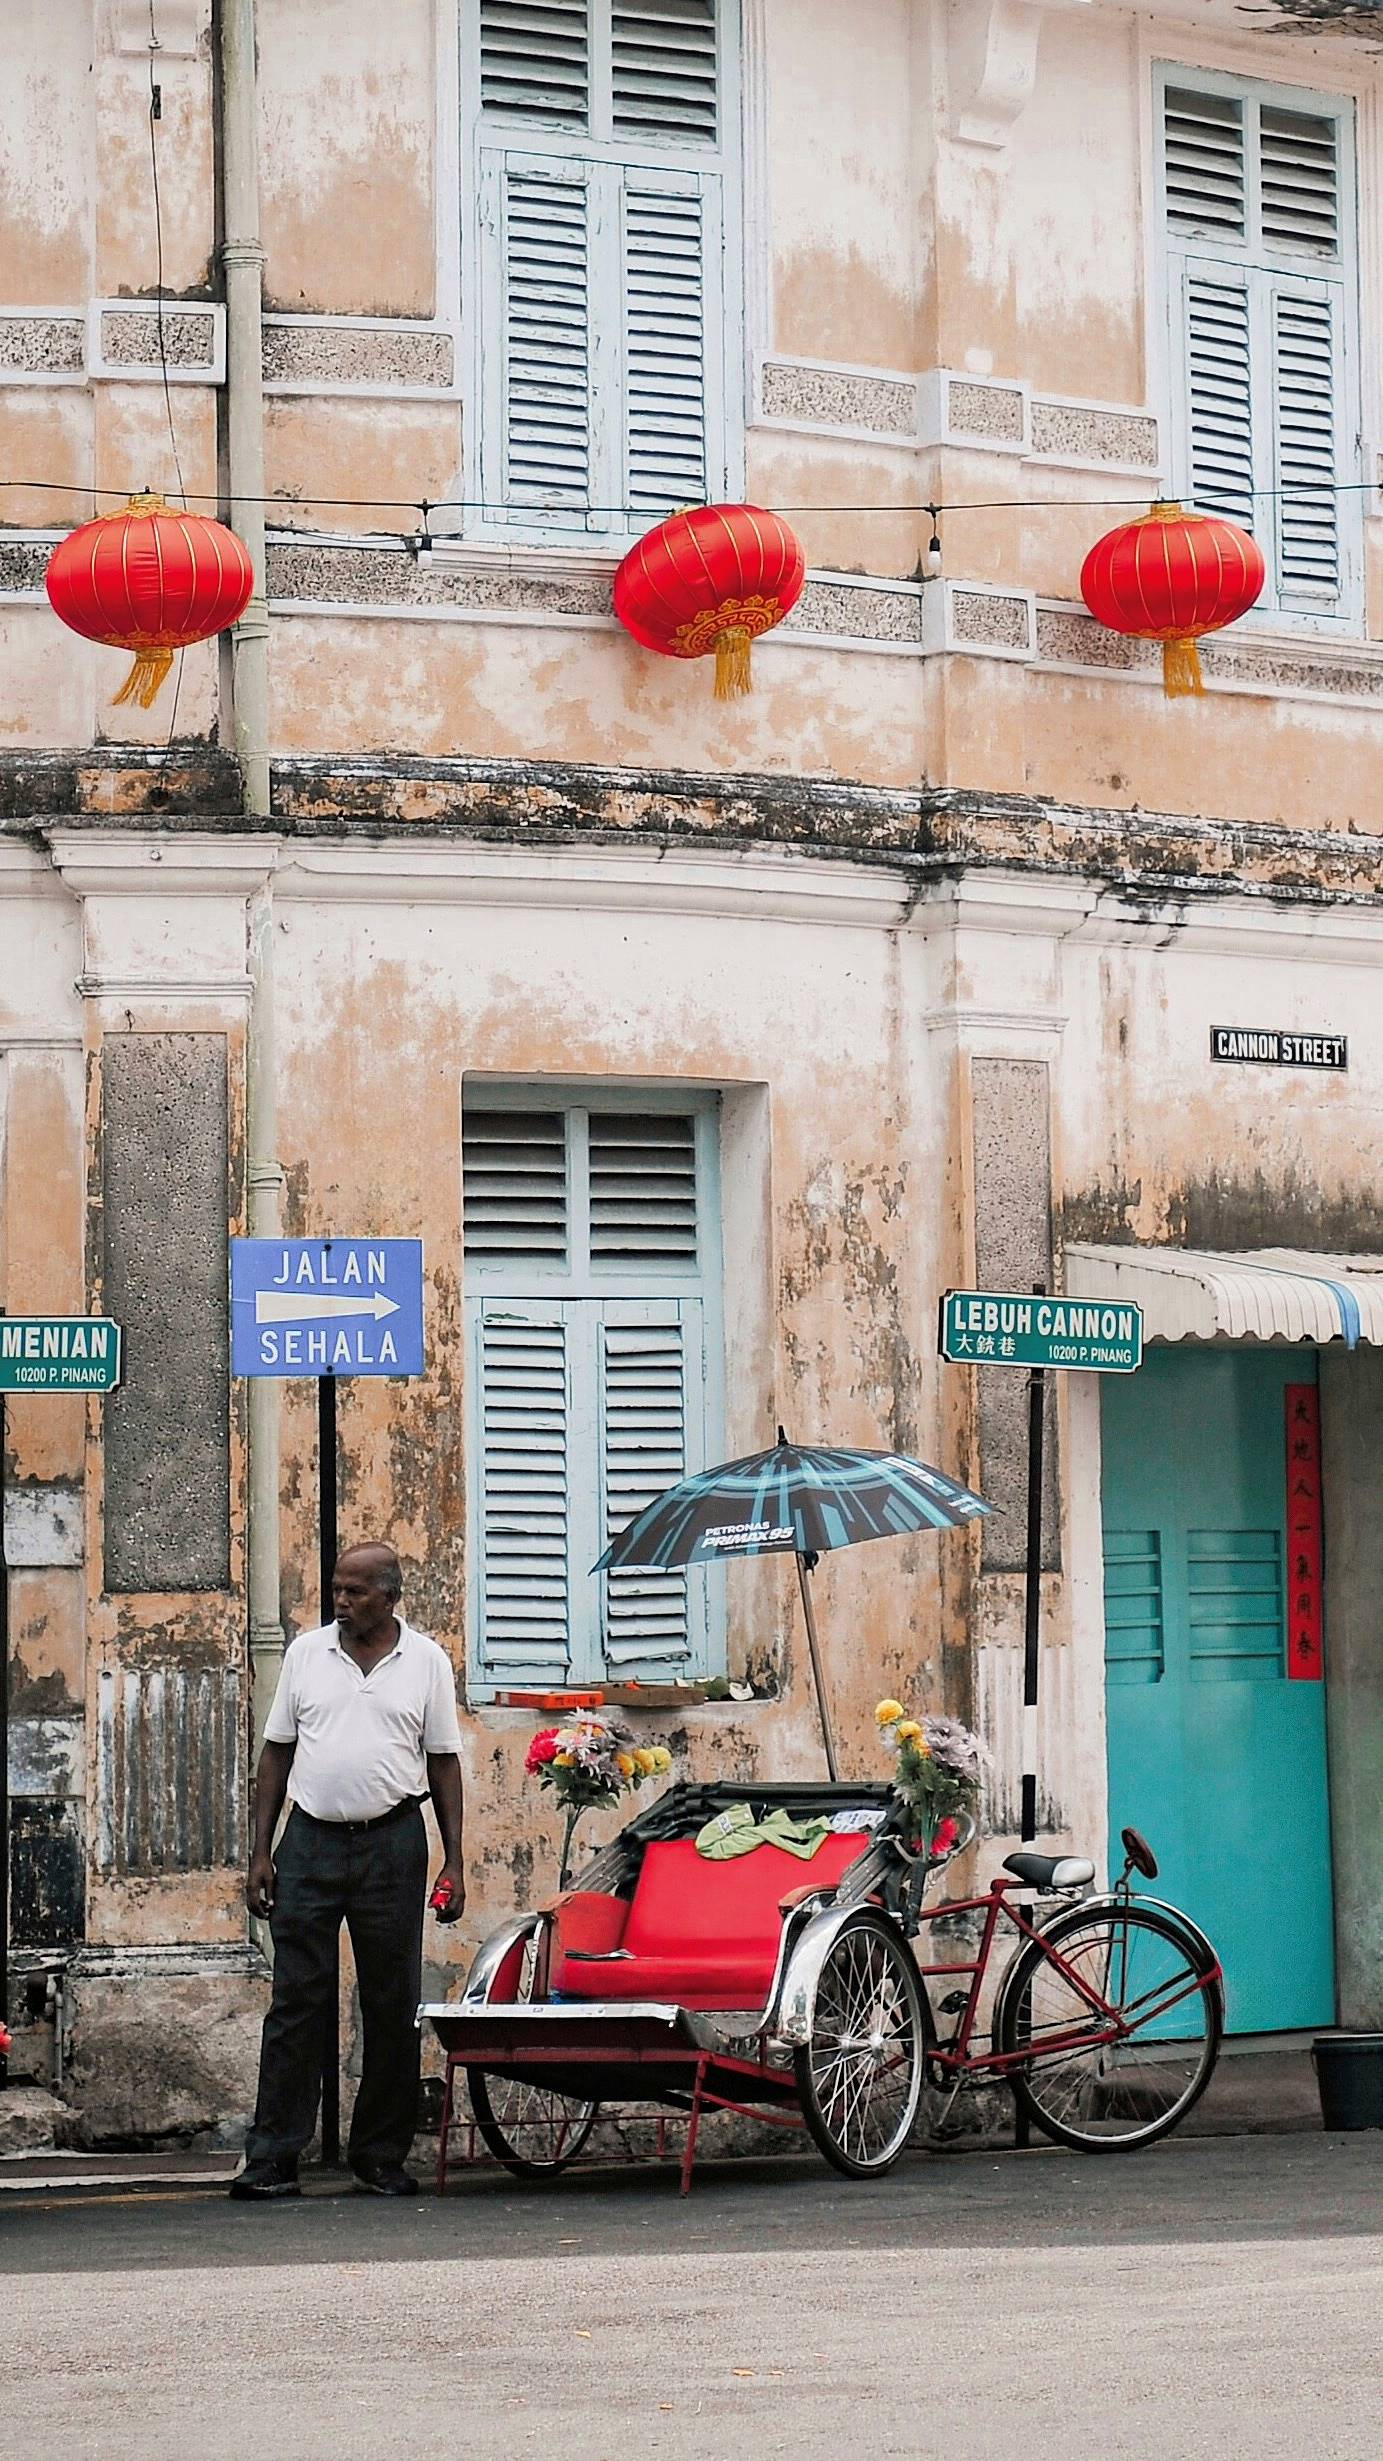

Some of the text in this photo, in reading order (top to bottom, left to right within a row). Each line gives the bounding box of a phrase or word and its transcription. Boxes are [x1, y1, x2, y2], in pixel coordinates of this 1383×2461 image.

[1217, 1031, 1342, 1065] CANNON STREET
[273, 1250, 386, 1285] JALAN
[954, 1299, 1134, 1341] LEBUH CANNON
[1, 1326, 108, 1358] MENIAN
[259, 1329, 398, 1365] SEHALA
[1048, 1344, 1132, 1364] 10200 P. PINANG
[14, 1367, 107, 1383] 10200 P. PINANG
[705, 1521, 770, 1537] PETRONAS
